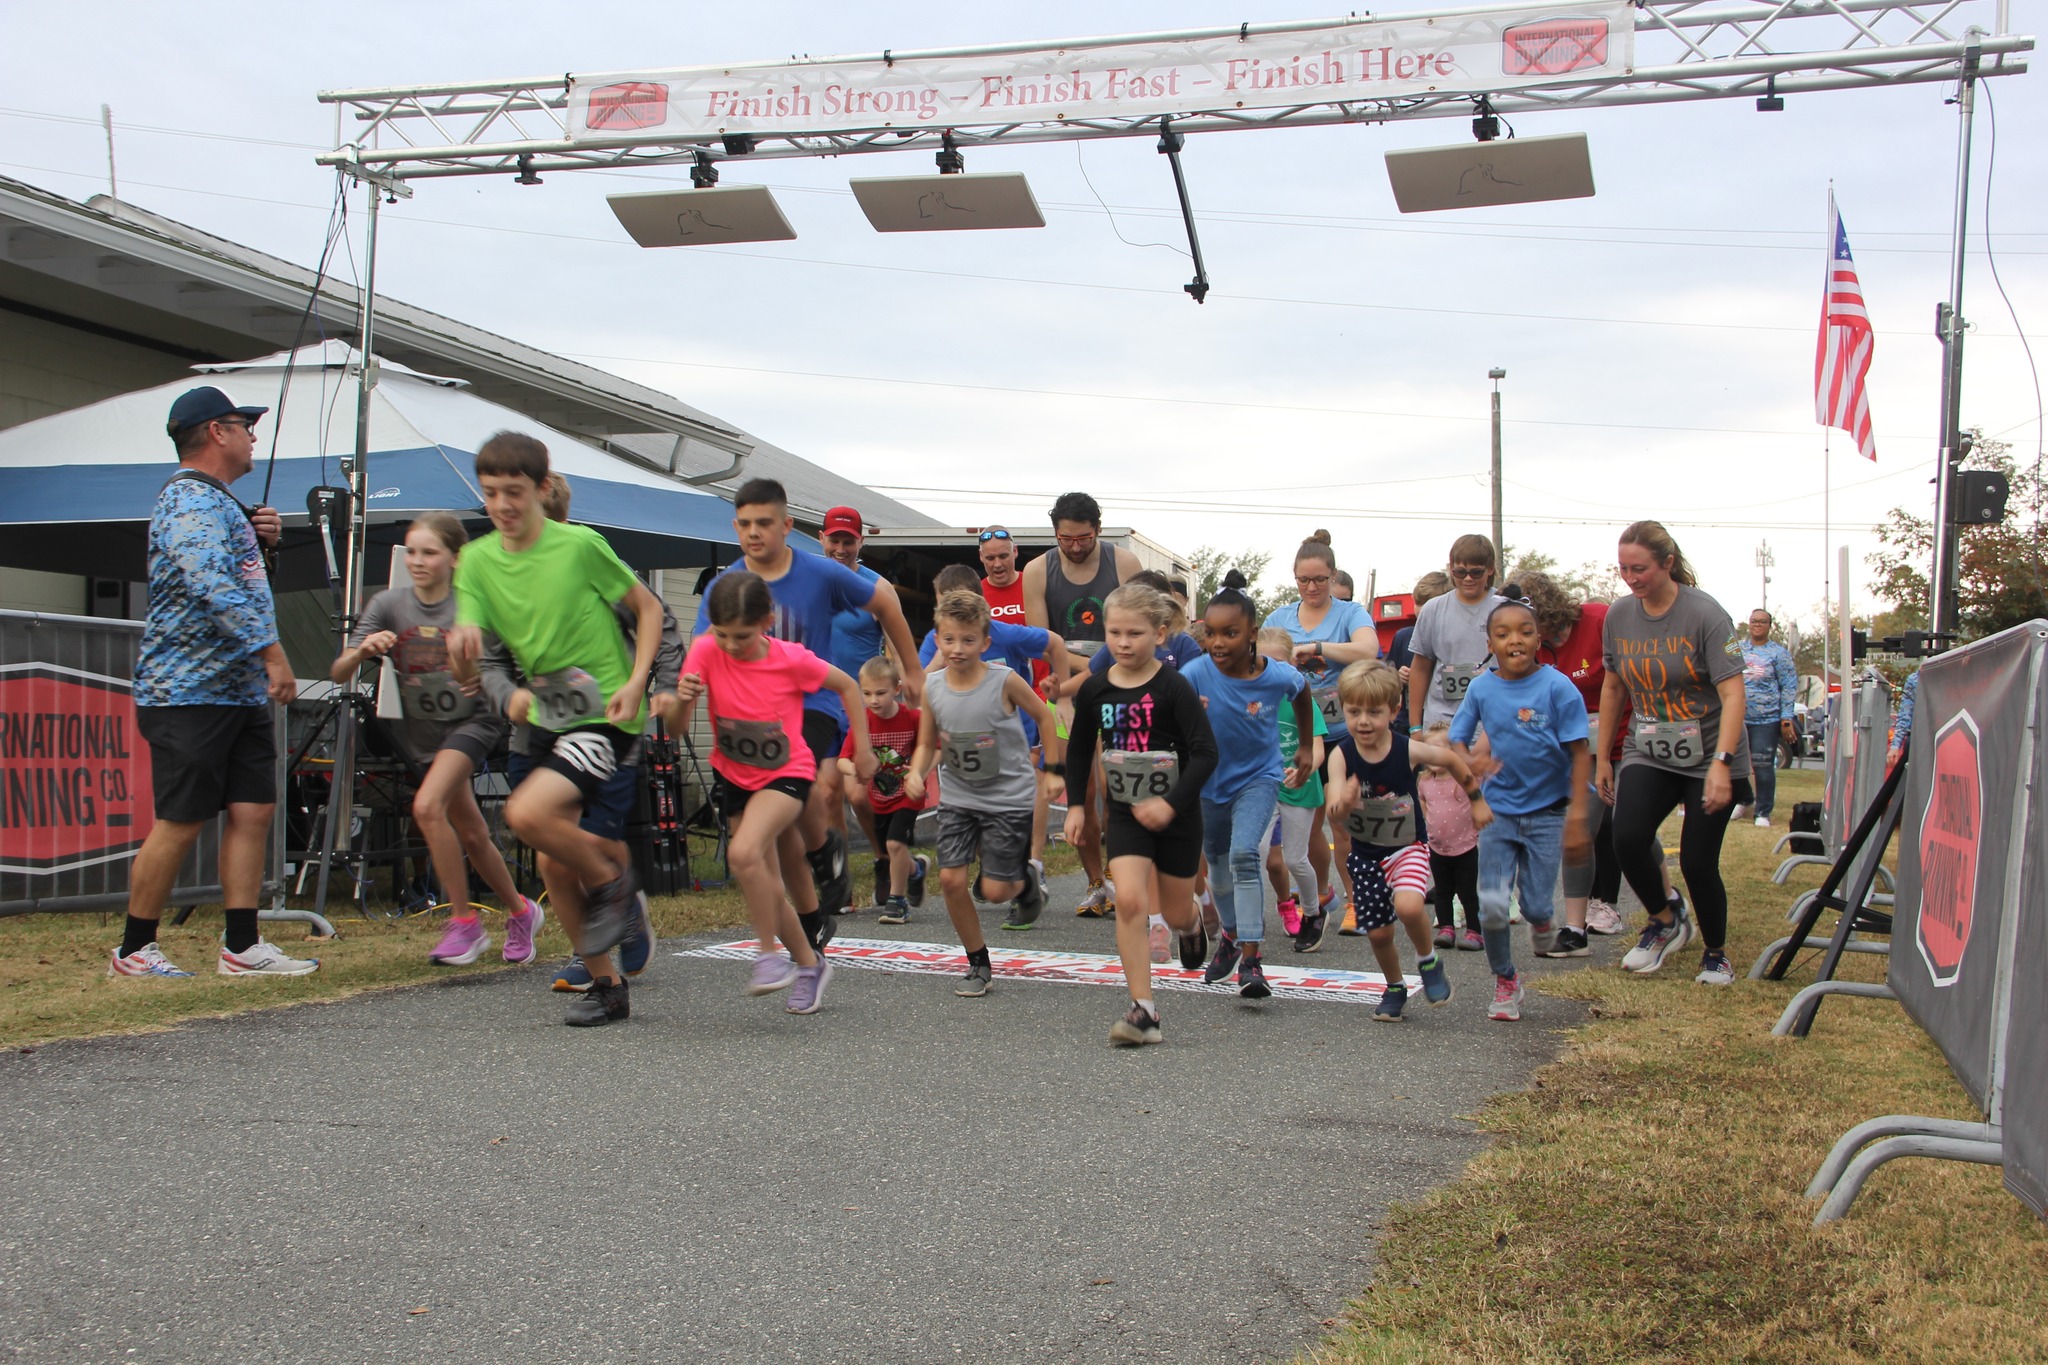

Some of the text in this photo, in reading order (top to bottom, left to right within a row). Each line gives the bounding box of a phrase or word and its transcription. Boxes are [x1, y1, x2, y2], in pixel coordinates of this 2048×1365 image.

[704, 85, 811, 117] Finish
[823, 85, 939, 120] Strong
[980, 69, 1092, 107] Finish
[1104, 67, 1180, 99] Fast
[1224, 50, 1345, 90] Finish
[1358, 47, 1455, 82] Here
[419, 689, 456, 713] 60
[1101, 703, 1155, 729] BEST
[720, 734, 781, 760] 400
[1645, 739, 1692, 761] 136
[1108, 769, 1170, 797] 378
[0, 768, 96, 830] NING
[1349, 812, 1405, 838] 377
